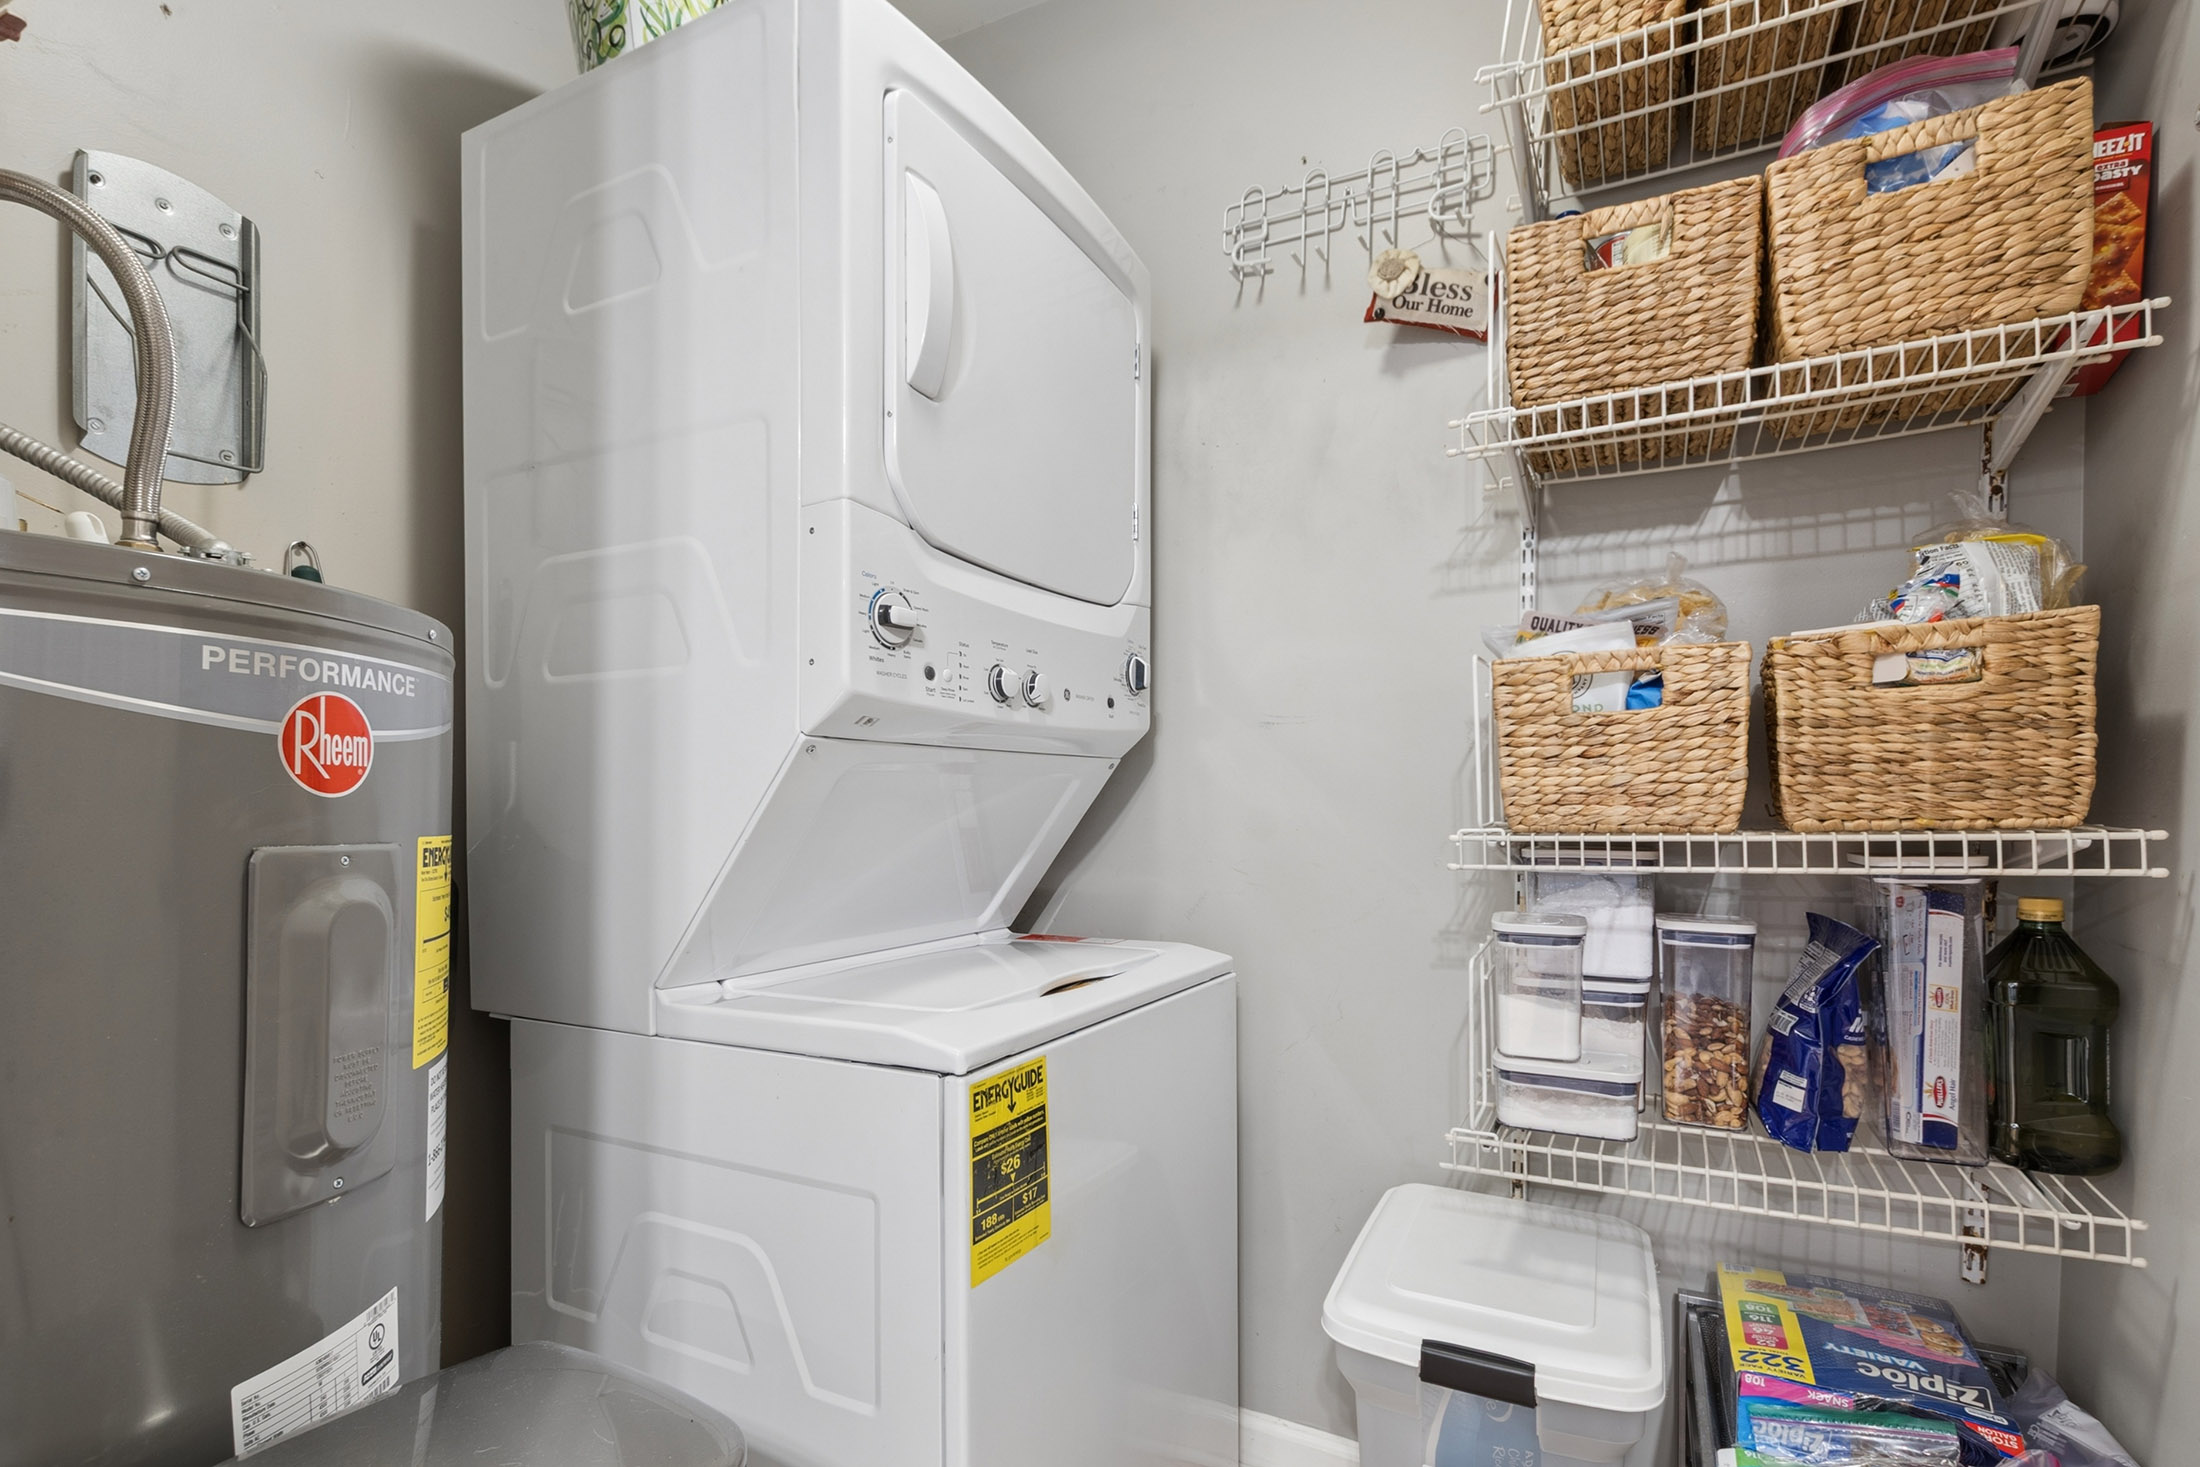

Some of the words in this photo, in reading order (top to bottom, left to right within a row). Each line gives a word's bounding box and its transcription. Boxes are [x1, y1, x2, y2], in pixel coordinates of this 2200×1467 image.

[1392, 295, 1424, 310] Our
[1427, 298, 1473, 318] Home
[1531, 616, 1584, 633] QUALITY
[202, 645, 416, 697] PERFORMANCE
[295, 696, 369, 779] Rheem
[973, 1065, 1044, 1113] ENERGYGUIDE
[1949, 1091, 1958, 1110] Angel
[1001, 1154, 1020, 1175] $26
[1022, 1187, 1038, 1204] $17
[981, 1213, 998, 1231] 188
[1745, 1303, 1773, 1313] 108
[1749, 1314, 1774, 1323] 116
[1757, 1339, 1776, 1347] 52
[1738, 1350, 1805, 1373] 322
[1823, 1342, 1928, 1372] VARIETY
[1745, 1374, 1765, 1387] 108
[1767, 1367, 1806, 1379] VARIETY
[1859, 1361, 1984, 1408] Ziploc
[1808, 1390, 1849, 1407] SNACK
[1753, 1420, 1824, 1453] Ziploc
[1977, 1426, 2016, 1442] GALLON
[1983, 1433, 2019, 1450] STOR
